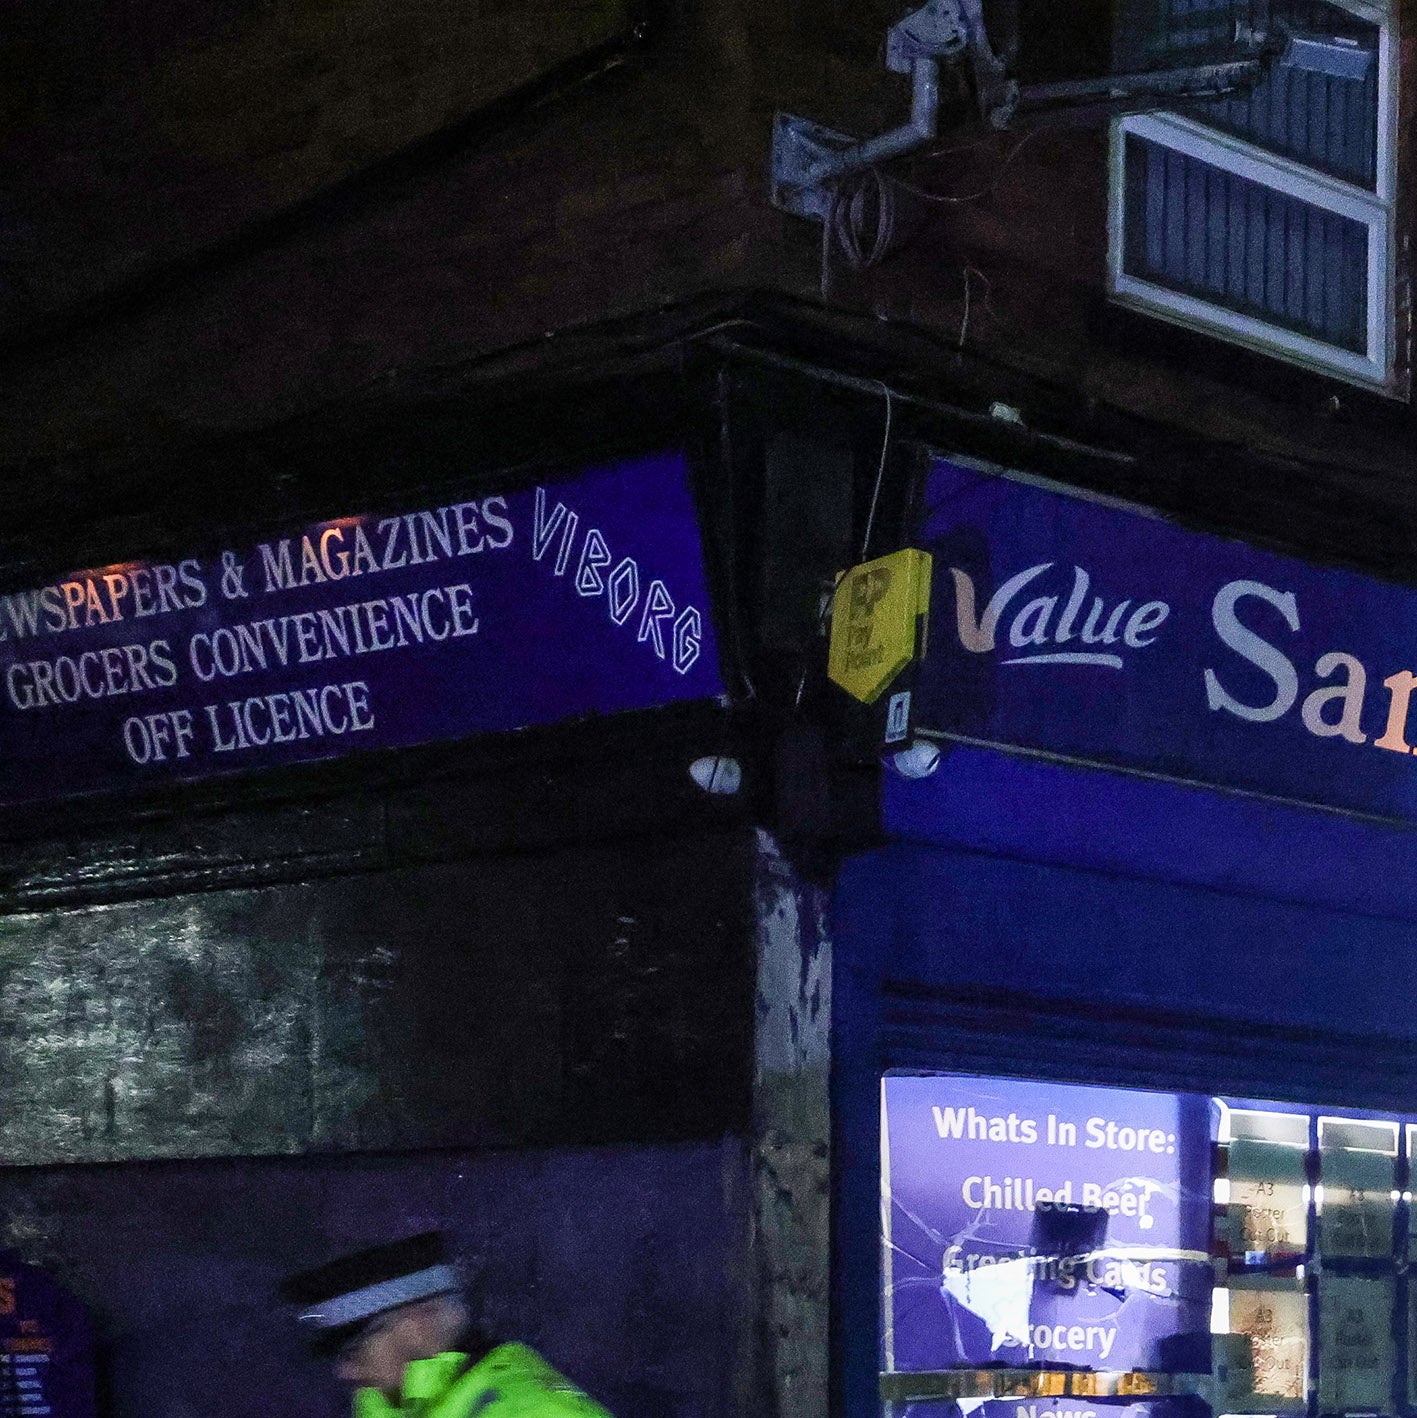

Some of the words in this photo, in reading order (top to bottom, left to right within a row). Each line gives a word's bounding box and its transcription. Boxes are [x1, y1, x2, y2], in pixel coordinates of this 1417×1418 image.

[0, 559, 207, 641] WSPAPERS
[222, 551, 248, 599] &
[259, 495, 514, 592] MAGAZINES
[532, 486, 702, 674] VIBORG
[950, 562, 1171, 654] Value
[7, 640, 177, 710] GROCERS
[189, 583, 479, 682] CONVENIENCE
[124, 709, 196, 765] OFF
[205, 681, 375, 754] LICENCE
[932, 1106, 1038, 1144] Whats
[1047, 1114, 1077, 1146] In
[1084, 1117, 1176, 1154] Store:
[962, 1176, 1072, 1212] Chilled
[1256, 1181, 1275, 1197] A3
